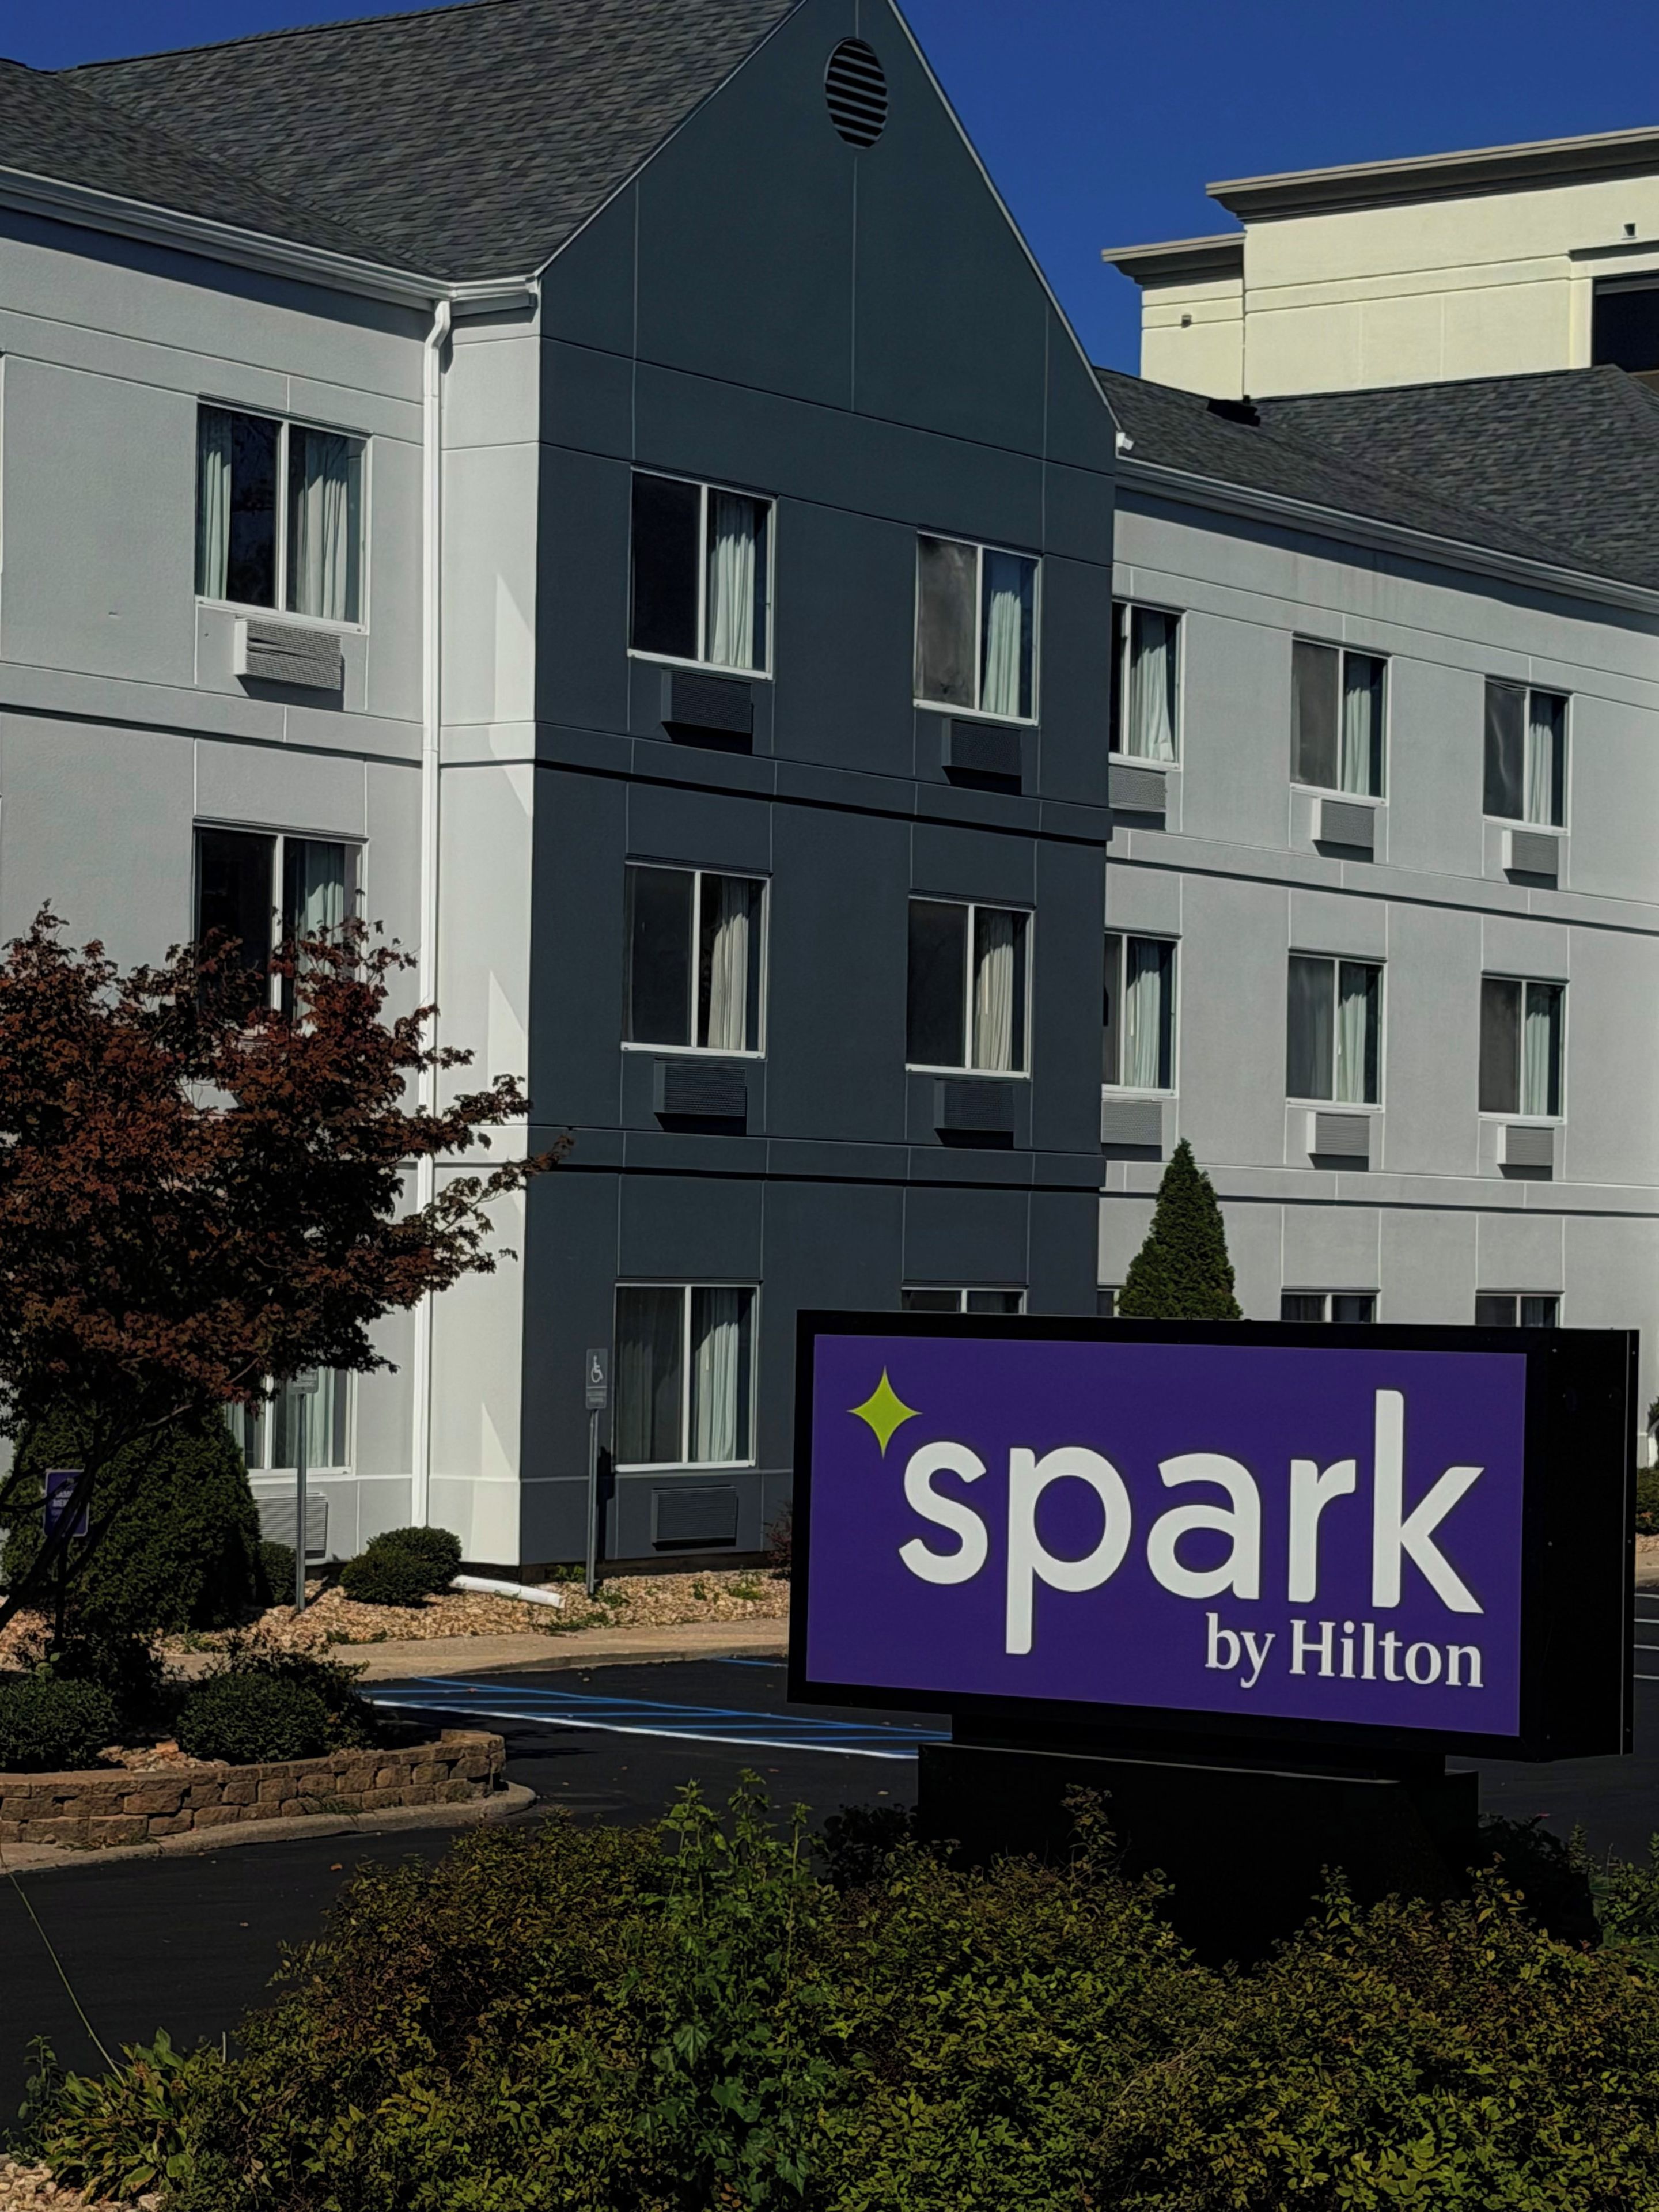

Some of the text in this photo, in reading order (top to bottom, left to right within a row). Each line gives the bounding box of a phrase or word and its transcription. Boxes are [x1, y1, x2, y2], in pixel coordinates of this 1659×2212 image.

[899, 1389, 1484, 1655] spark
[1205, 1612, 1484, 1688] by Hilton
